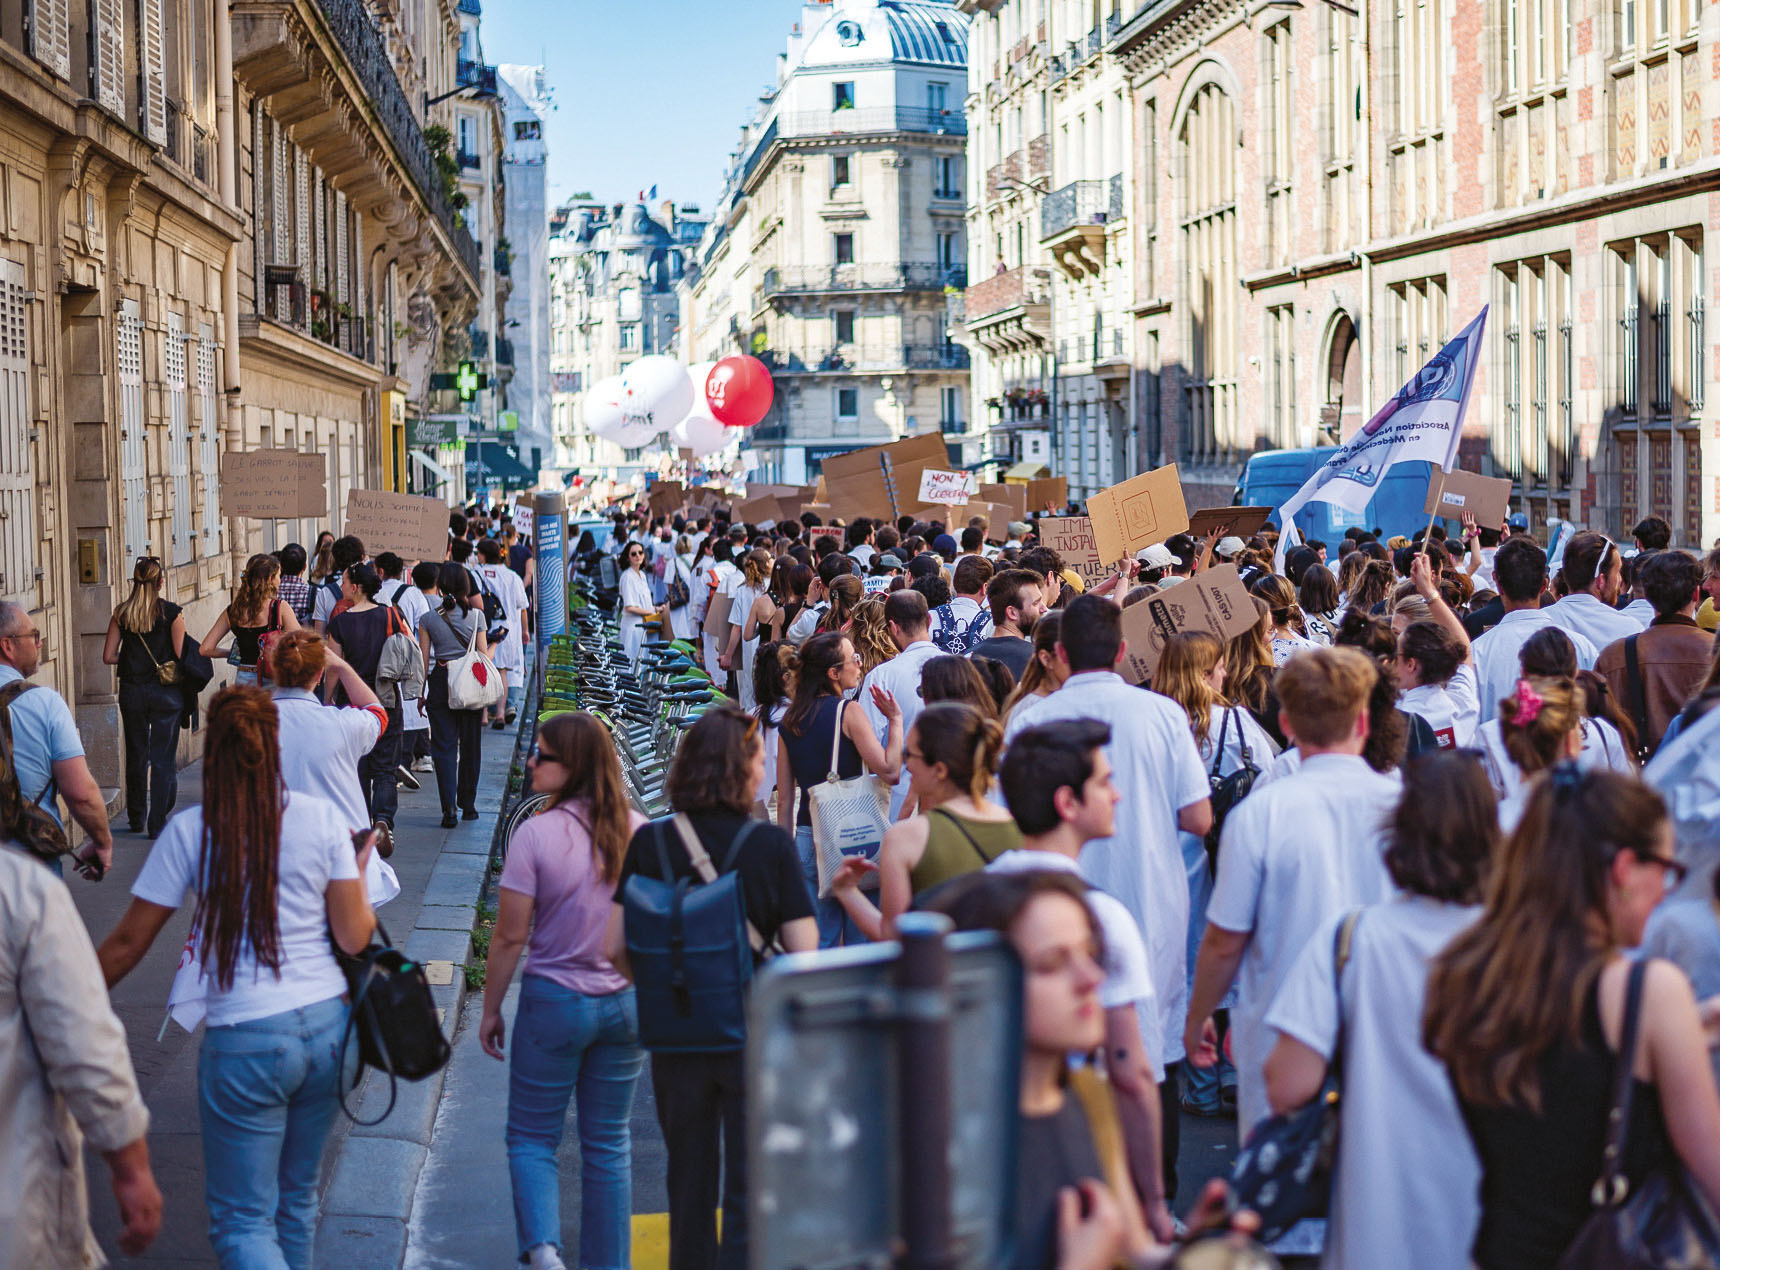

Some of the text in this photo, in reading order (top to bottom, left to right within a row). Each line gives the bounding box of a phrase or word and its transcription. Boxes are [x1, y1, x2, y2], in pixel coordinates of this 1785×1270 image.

[931, 472, 955, 484] NON
[352, 498, 385, 510] NOUS
[1210, 586, 1232, 621] CAS1007
[1153, 601, 1175, 636] mmette
